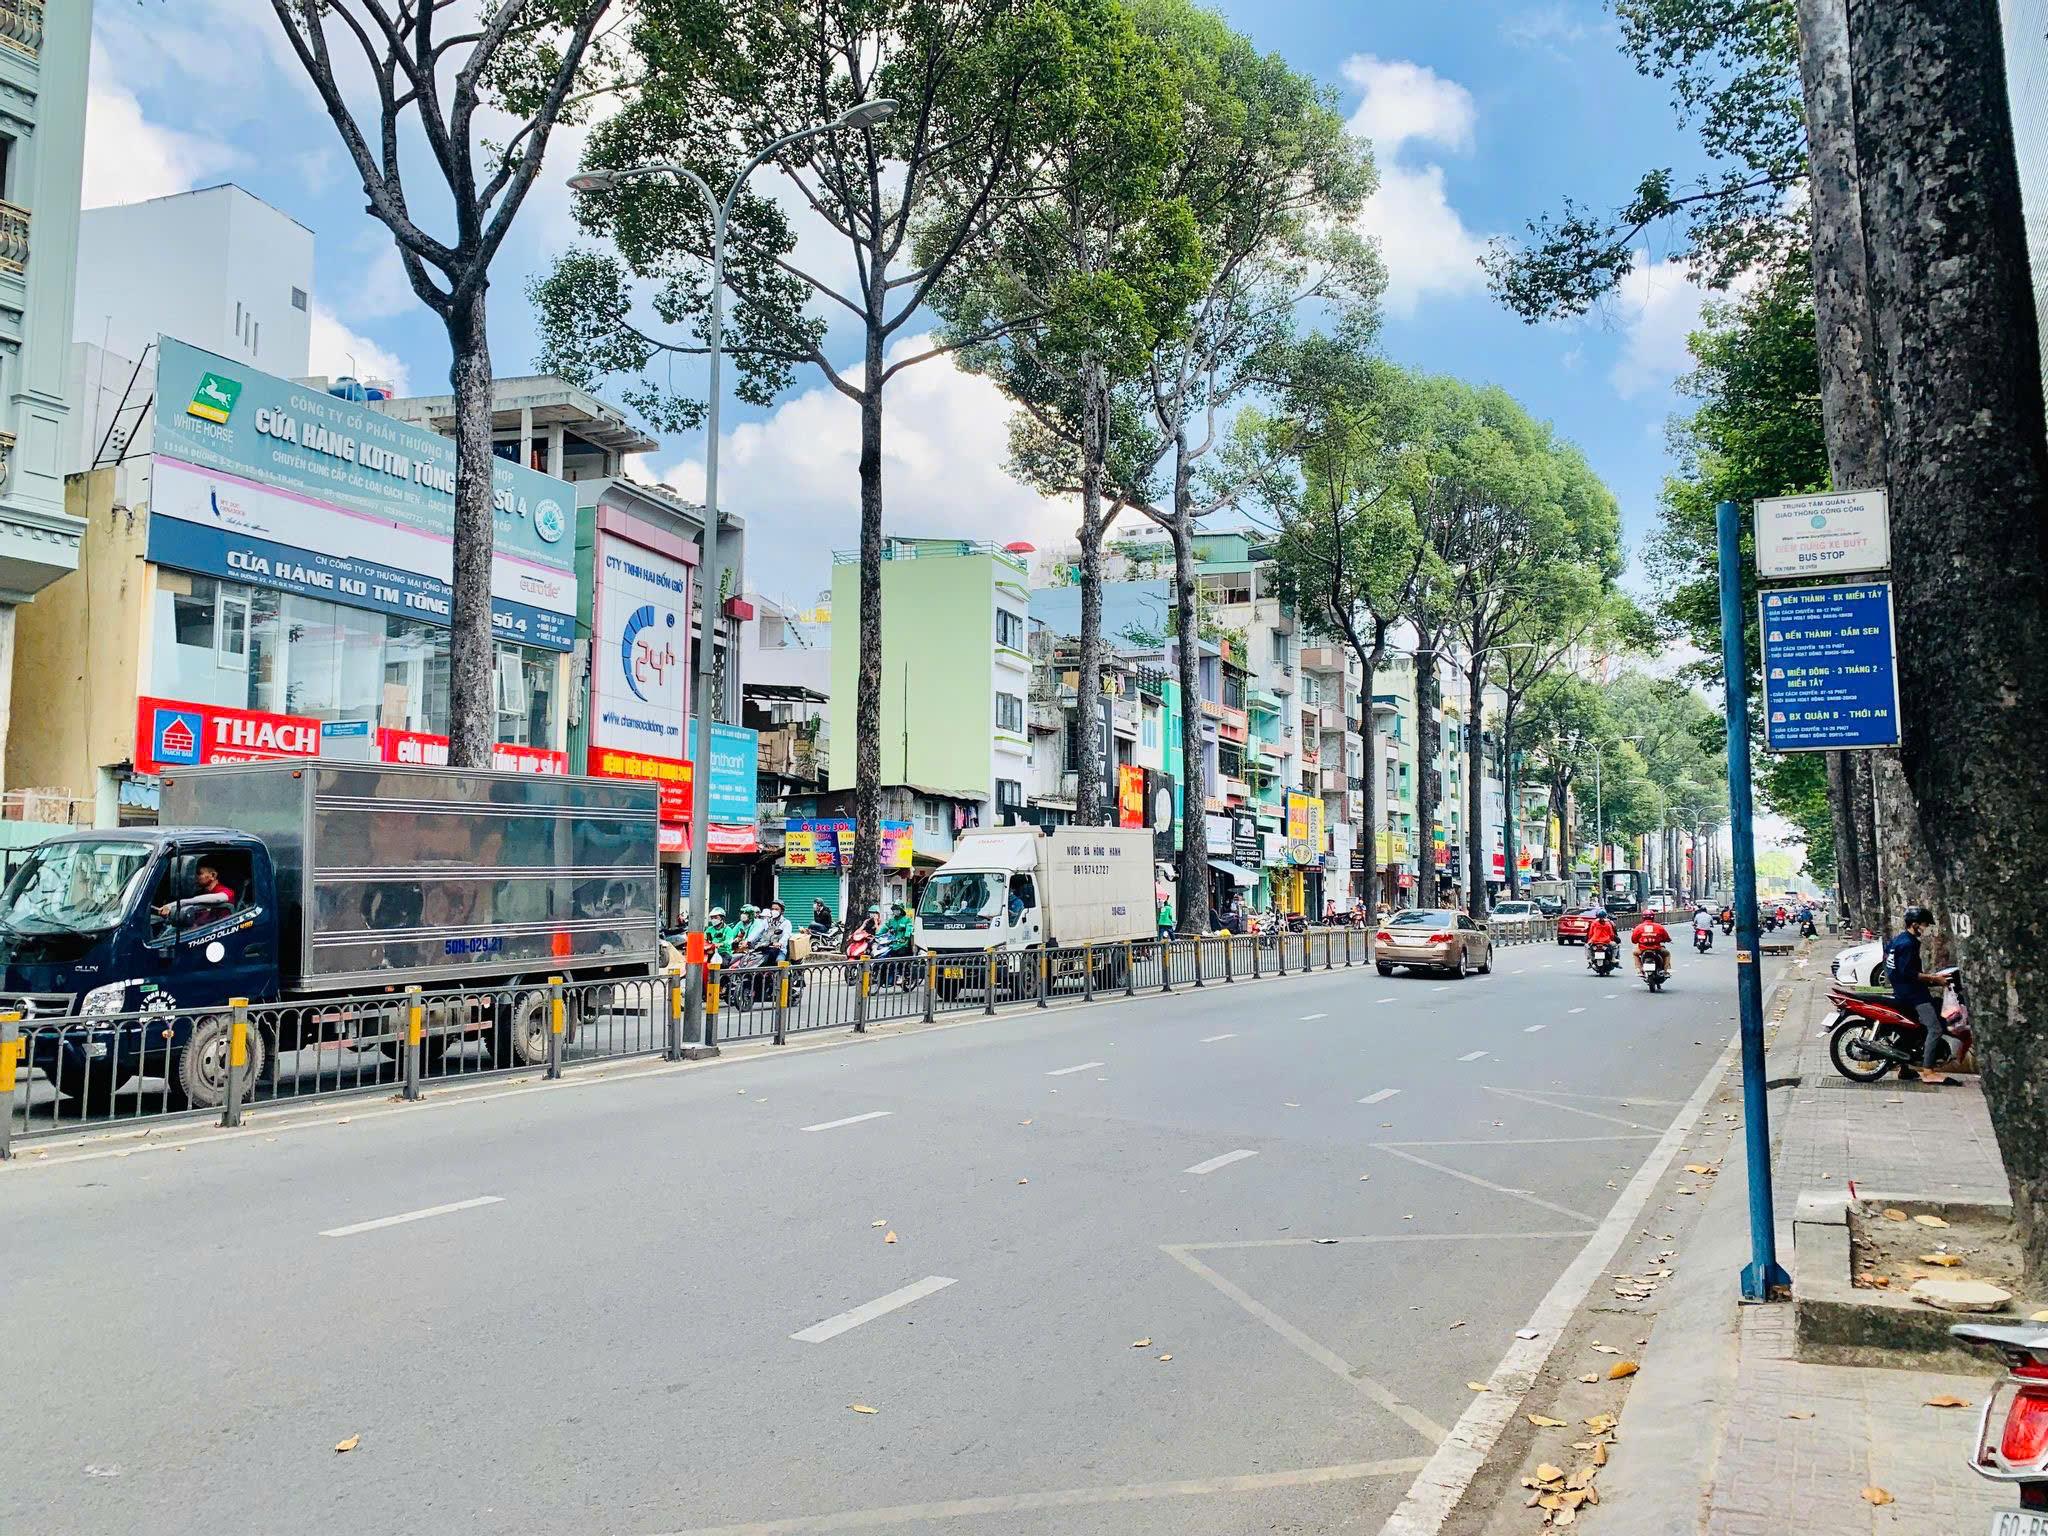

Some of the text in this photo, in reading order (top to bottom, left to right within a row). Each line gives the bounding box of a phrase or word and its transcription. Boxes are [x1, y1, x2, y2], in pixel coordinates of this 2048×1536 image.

[173, 412, 201, 433] WHITE
[203, 423, 234, 443] HORSE
[291, 394, 325, 417] CÔNG
[327, 408, 343, 423] TY
[347, 412, 364, 430] CỔ
[366, 421, 396, 442] PHẦN
[400, 432, 442, 458] THƯƠNG
[255, 405, 297, 444] CỬA
[302, 423, 355, 462] HÀNG
[359, 442, 409, 479] KDTM
[412, 458, 456, 495] TỔNG
[494, 486, 514, 513] SỐ
[516, 497, 528, 518] 4
[272, 450, 307, 471] CHUYÊN
[308, 461, 329, 477] CUNG
[331, 465, 347, 482] CẤP
[1782, 502, 1806, 510] TRUNG
[1795, 509, 1819, 517] THÔNG
[1821, 506, 1842, 515] CÔNG
[1799, 550, 1845, 562] BUS STOP
[315, 556, 327, 566] CN
[329, 559, 352, 571] CÔNG
[354, 565, 363, 574] TY
[365, 567, 374, 577] CP
[376, 570, 405, 584] THƯƠNG
[407, 579, 421, 589] MẠI
[422, 578, 440, 592] TỔNG
[606, 555, 622, 571] CTY
[623, 561, 643, 579] TNHH
[643, 569, 656, 584] HAI
[656, 571, 671, 589] BỐN
[227, 550, 528, 632] CỬA HÀNG KD TM TỔNG SỐ 4
[1783, 595, 1798, 604] BẾN
[1801, 594, 1826, 603] THÀNH
[1833, 593, 1843, 601] BX
[1846, 591, 1865, 600] MIỀN
[1868, 590, 1883, 599] TÂY
[1785, 627, 1880, 640] BẾN THÀNH ĐẦM SEN
[635, 640, 675, 686] 24h
[1787, 667, 1806, 677] MIỀN
[1809, 666, 1830, 676] ĐÔNG
[1838, 667, 1843, 675] 3
[1845, 665, 1870, 674] THÁNG
[1788, 678, 1824, 688] MIỀN TÂY
[1789, 712, 1801, 721] BX
[1804, 711, 1830, 721] QUẬN
[1849, 708, 1871, 718] THỚI
[1874, 709, 1888, 717] AN
[1066, 845, 1080, 856] NƯỚC
[188, 925, 240, 948] THACO OLLIN
[74, 965, 99, 973] OLLIN
